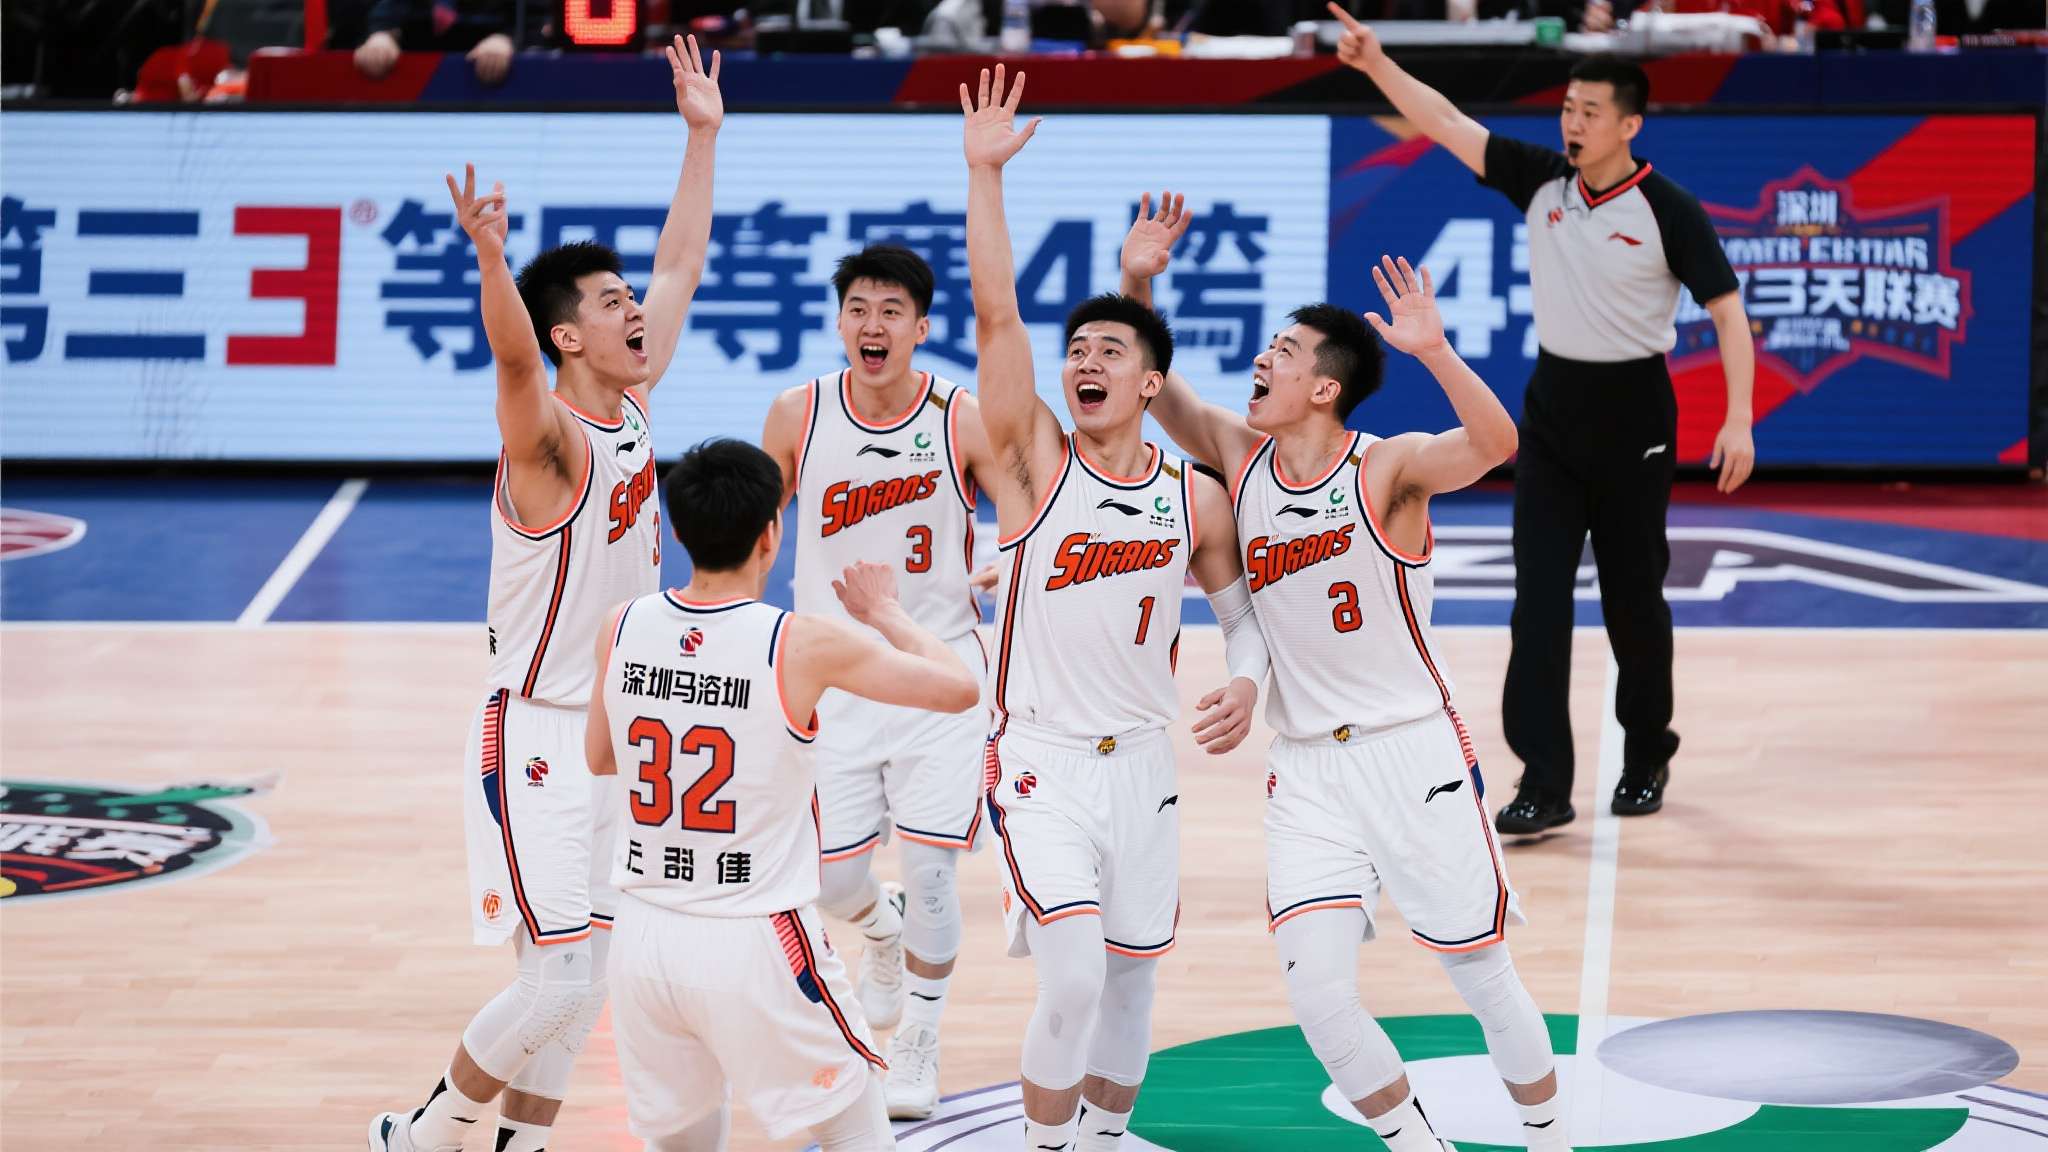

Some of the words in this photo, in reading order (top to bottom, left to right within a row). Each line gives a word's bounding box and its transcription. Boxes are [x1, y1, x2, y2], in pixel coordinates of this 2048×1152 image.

[905, 525, 932, 573] 3
[1134, 595, 1156, 645] 1
[628, 715, 737, 834] 32
